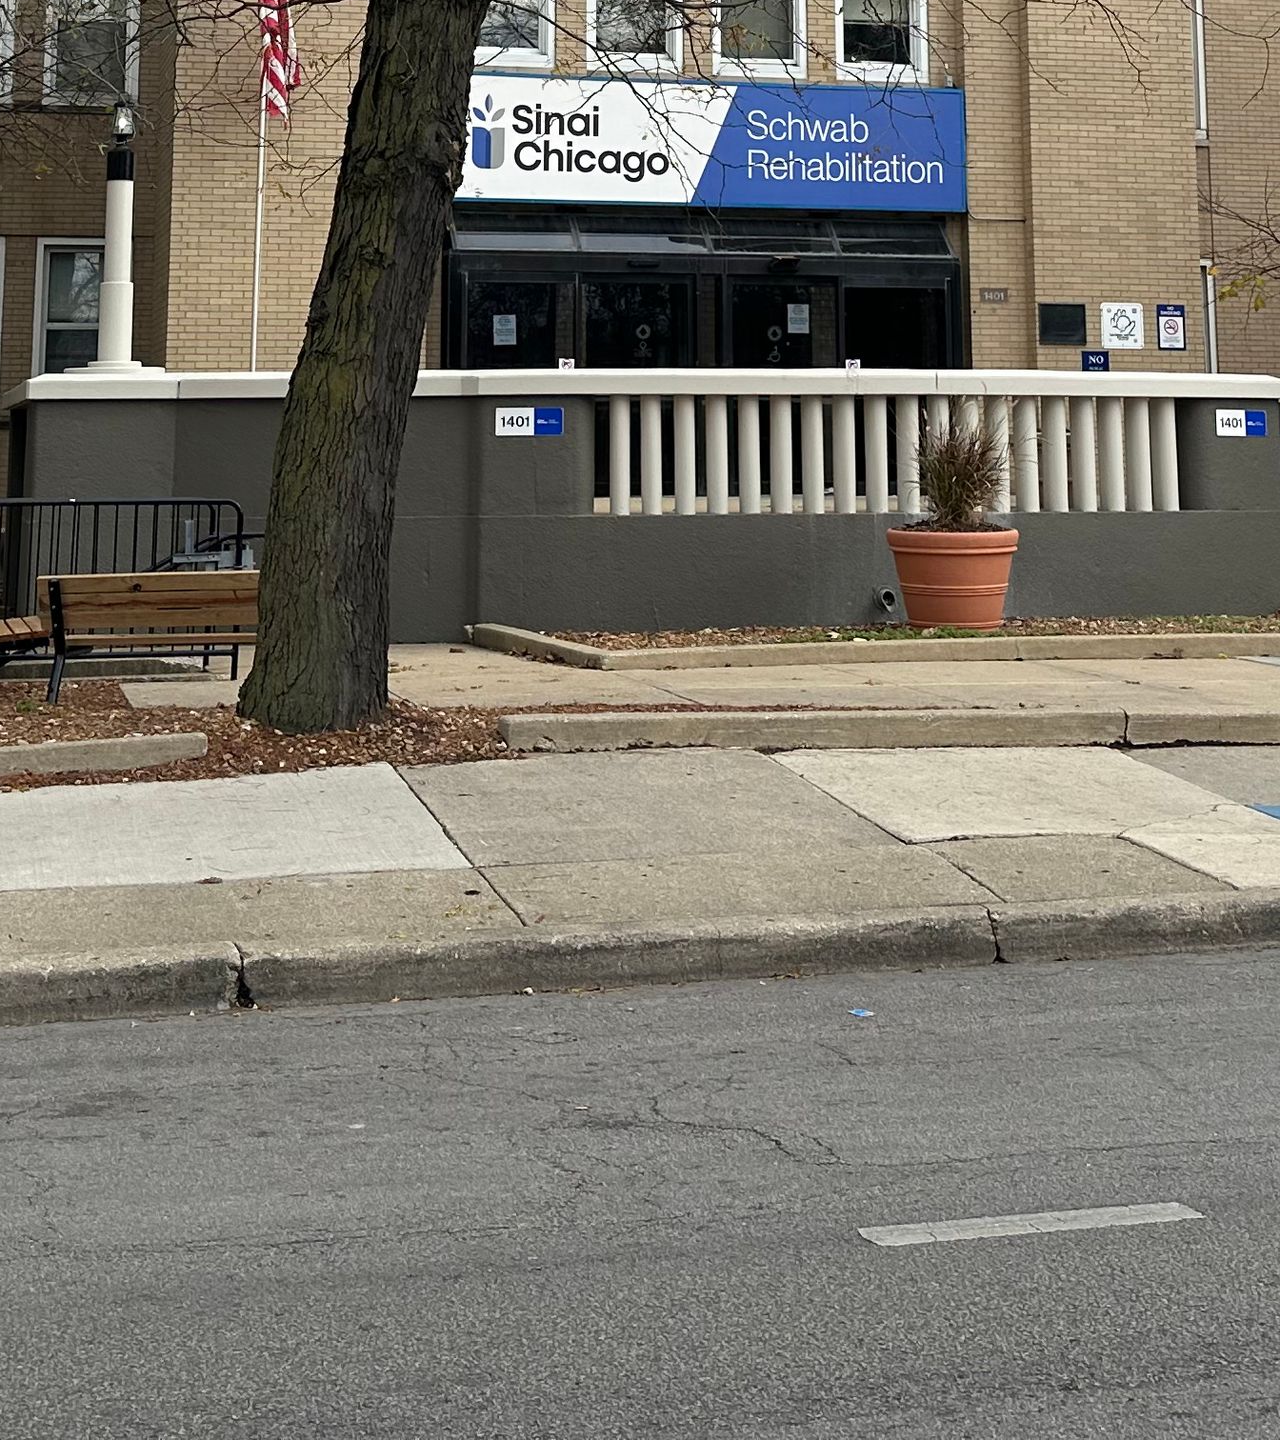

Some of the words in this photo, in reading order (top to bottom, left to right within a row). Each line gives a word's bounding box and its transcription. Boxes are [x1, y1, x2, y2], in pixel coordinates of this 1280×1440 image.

[512, 103, 599, 137] Sinai
[746, 109, 869, 143] Schwab
[514, 140, 670, 183] Chicago
[747, 149, 944, 184] Rehabilitation
[983, 291, 1005, 301] 1401
[1088, 355, 1104, 365] NO
[500, 415, 530, 428] 1401
[1219, 417, 1243, 429] 1401
